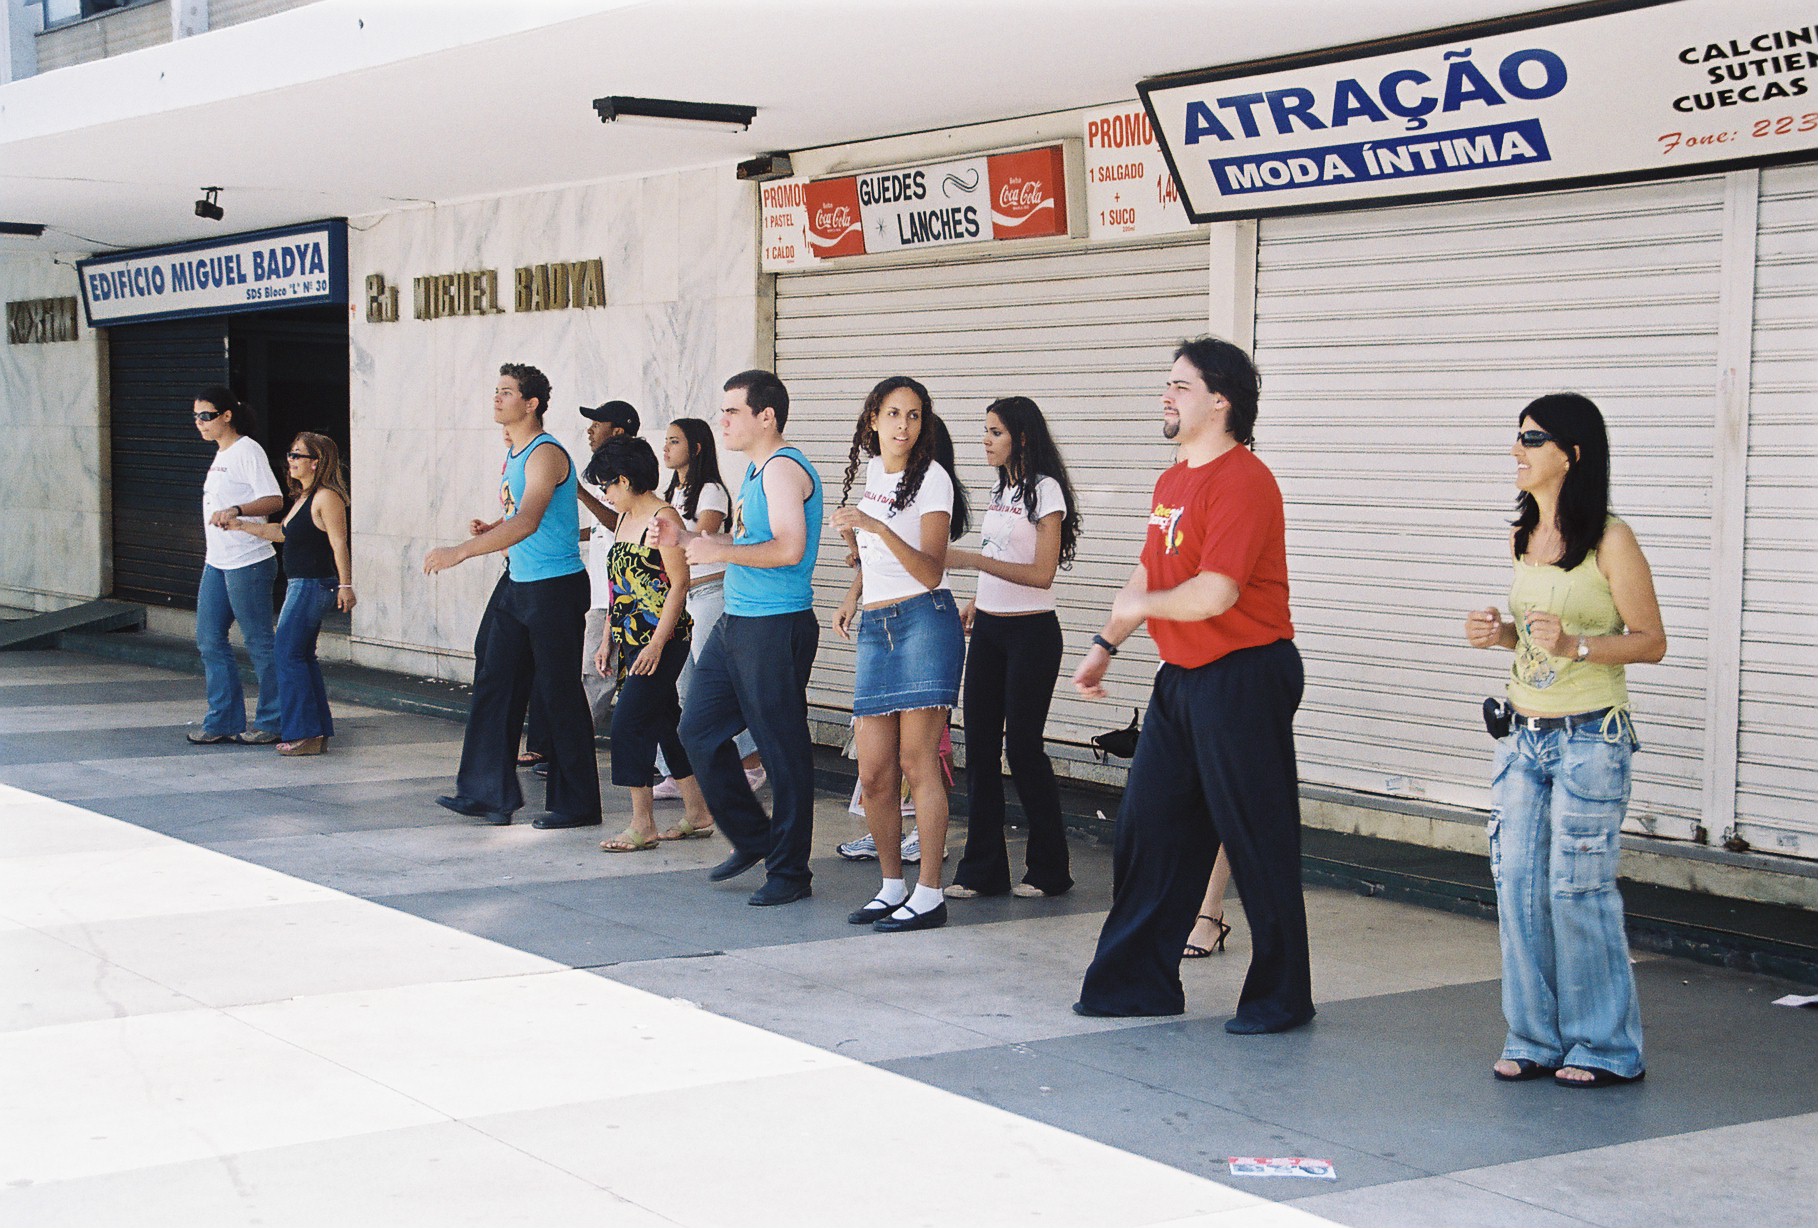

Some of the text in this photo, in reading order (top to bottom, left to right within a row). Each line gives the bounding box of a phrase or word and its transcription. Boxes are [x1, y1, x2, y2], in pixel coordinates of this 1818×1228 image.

[1678, 25, 1818, 64] CALCIN
[1185, 47, 1568, 146] ATRAÇÃO
[1672, 77, 1808, 112] CUECAS
[1088, 111, 1160, 152] PROMO
[1658, 131, 1738, 154] Fone:
[1089, 162, 1144, 183] 1 SALGADO
[1225, 130, 1538, 190] MODA ÍNTIMA
[859, 171, 927, 207] GUEDES
[764, 213, 795, 228] 1 PASTEL
[897, 206, 980, 245] LANCHES
[1100, 208, 1135, 226] 1 SUCO
[171, 254, 247, 292] MIGUEL
[252, 242, 325, 283] BADYA
[765, 245, 795, 259] 1 CALDO
[246, 288, 262, 300] SDS
[316, 279, 328, 292] 30
